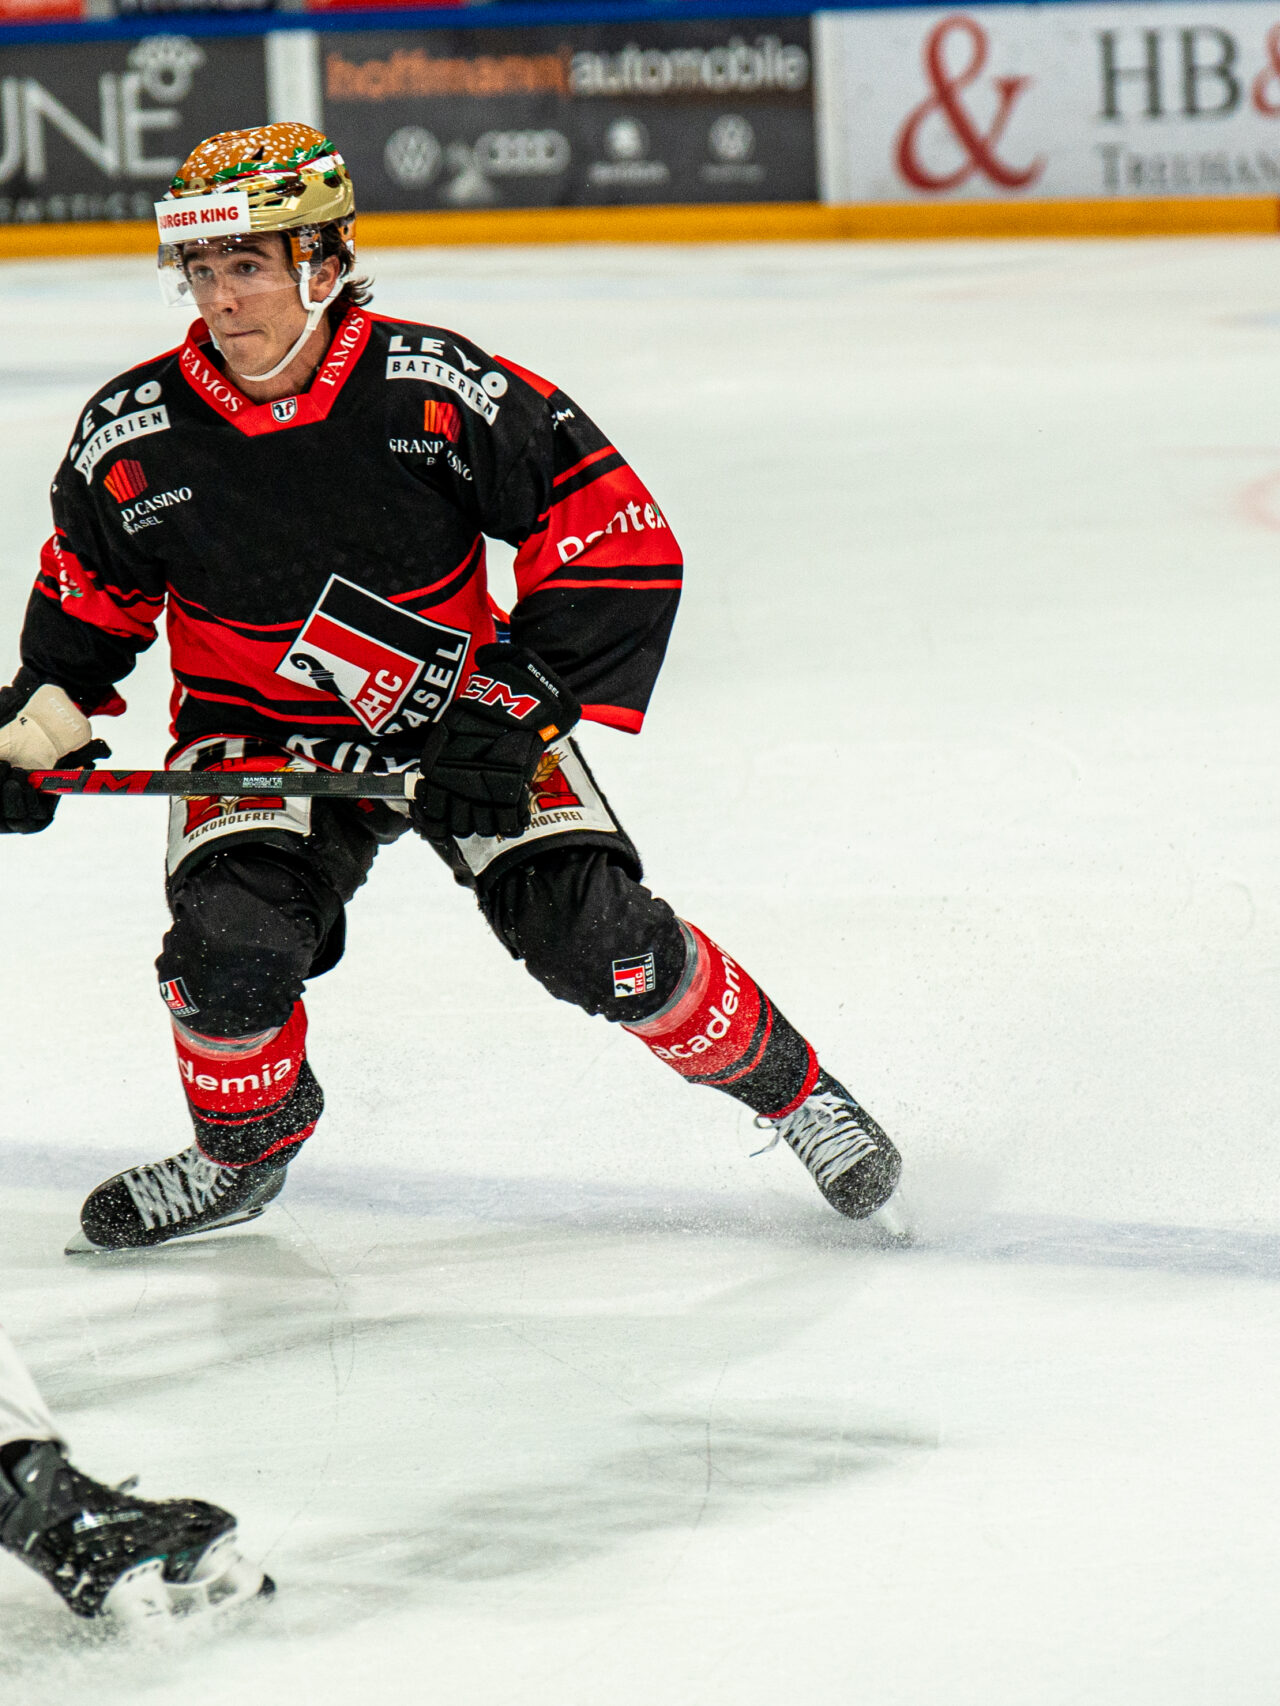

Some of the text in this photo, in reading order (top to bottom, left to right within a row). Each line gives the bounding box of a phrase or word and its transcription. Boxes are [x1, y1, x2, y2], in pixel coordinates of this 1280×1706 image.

[200, 206, 239, 224] KING
[319, 315, 366, 387] FAMOS
[181, 346, 244, 413] FAMOS
[392, 360, 495, 416] BATTERIEN
[135, 487, 193, 516] CASINO
[527, 663, 560, 698] EHC BASEL
[188, 811, 276, 843] ALKOHOLFREI
